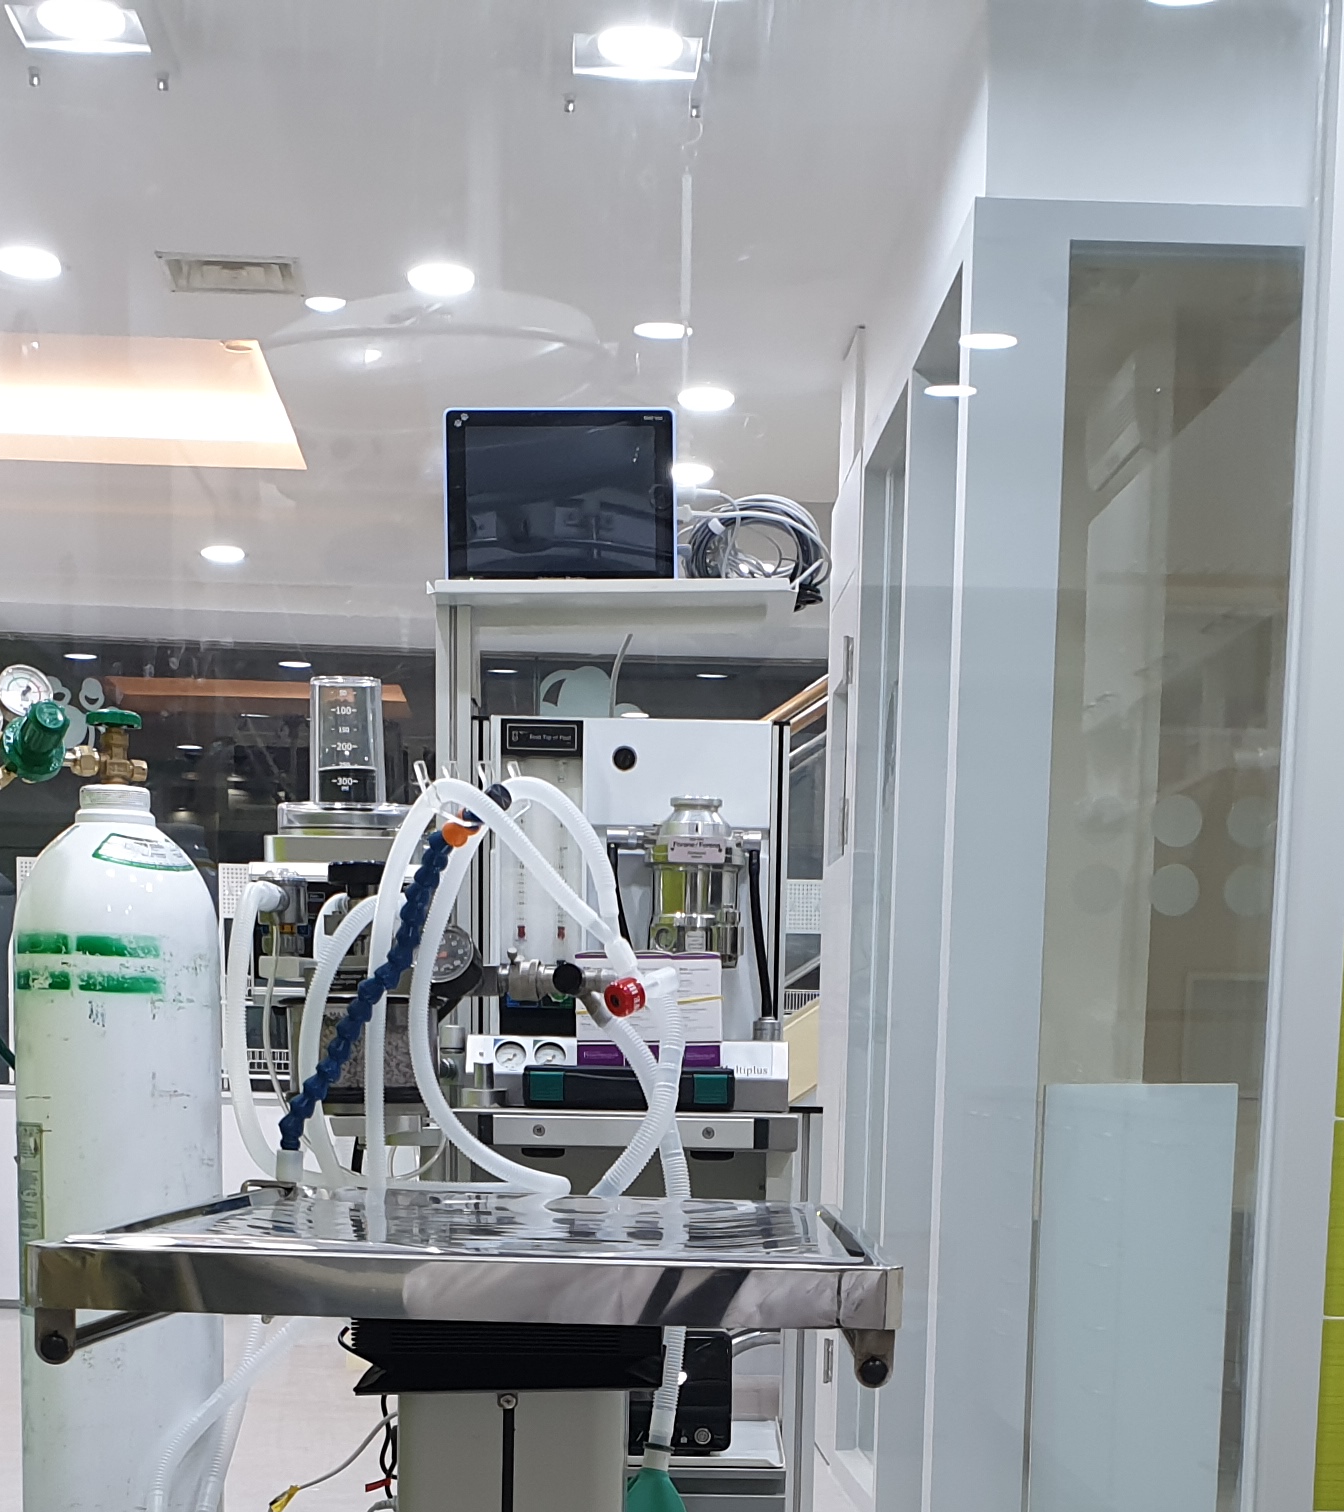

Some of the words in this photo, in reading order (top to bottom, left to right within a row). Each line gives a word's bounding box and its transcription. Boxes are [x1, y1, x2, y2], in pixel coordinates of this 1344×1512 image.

[336, 706, 352, 715] 100
[336, 742, 352, 751] 200
[336, 777, 353, 786] 300
[721, 1065, 768, 1077] ltiplus
